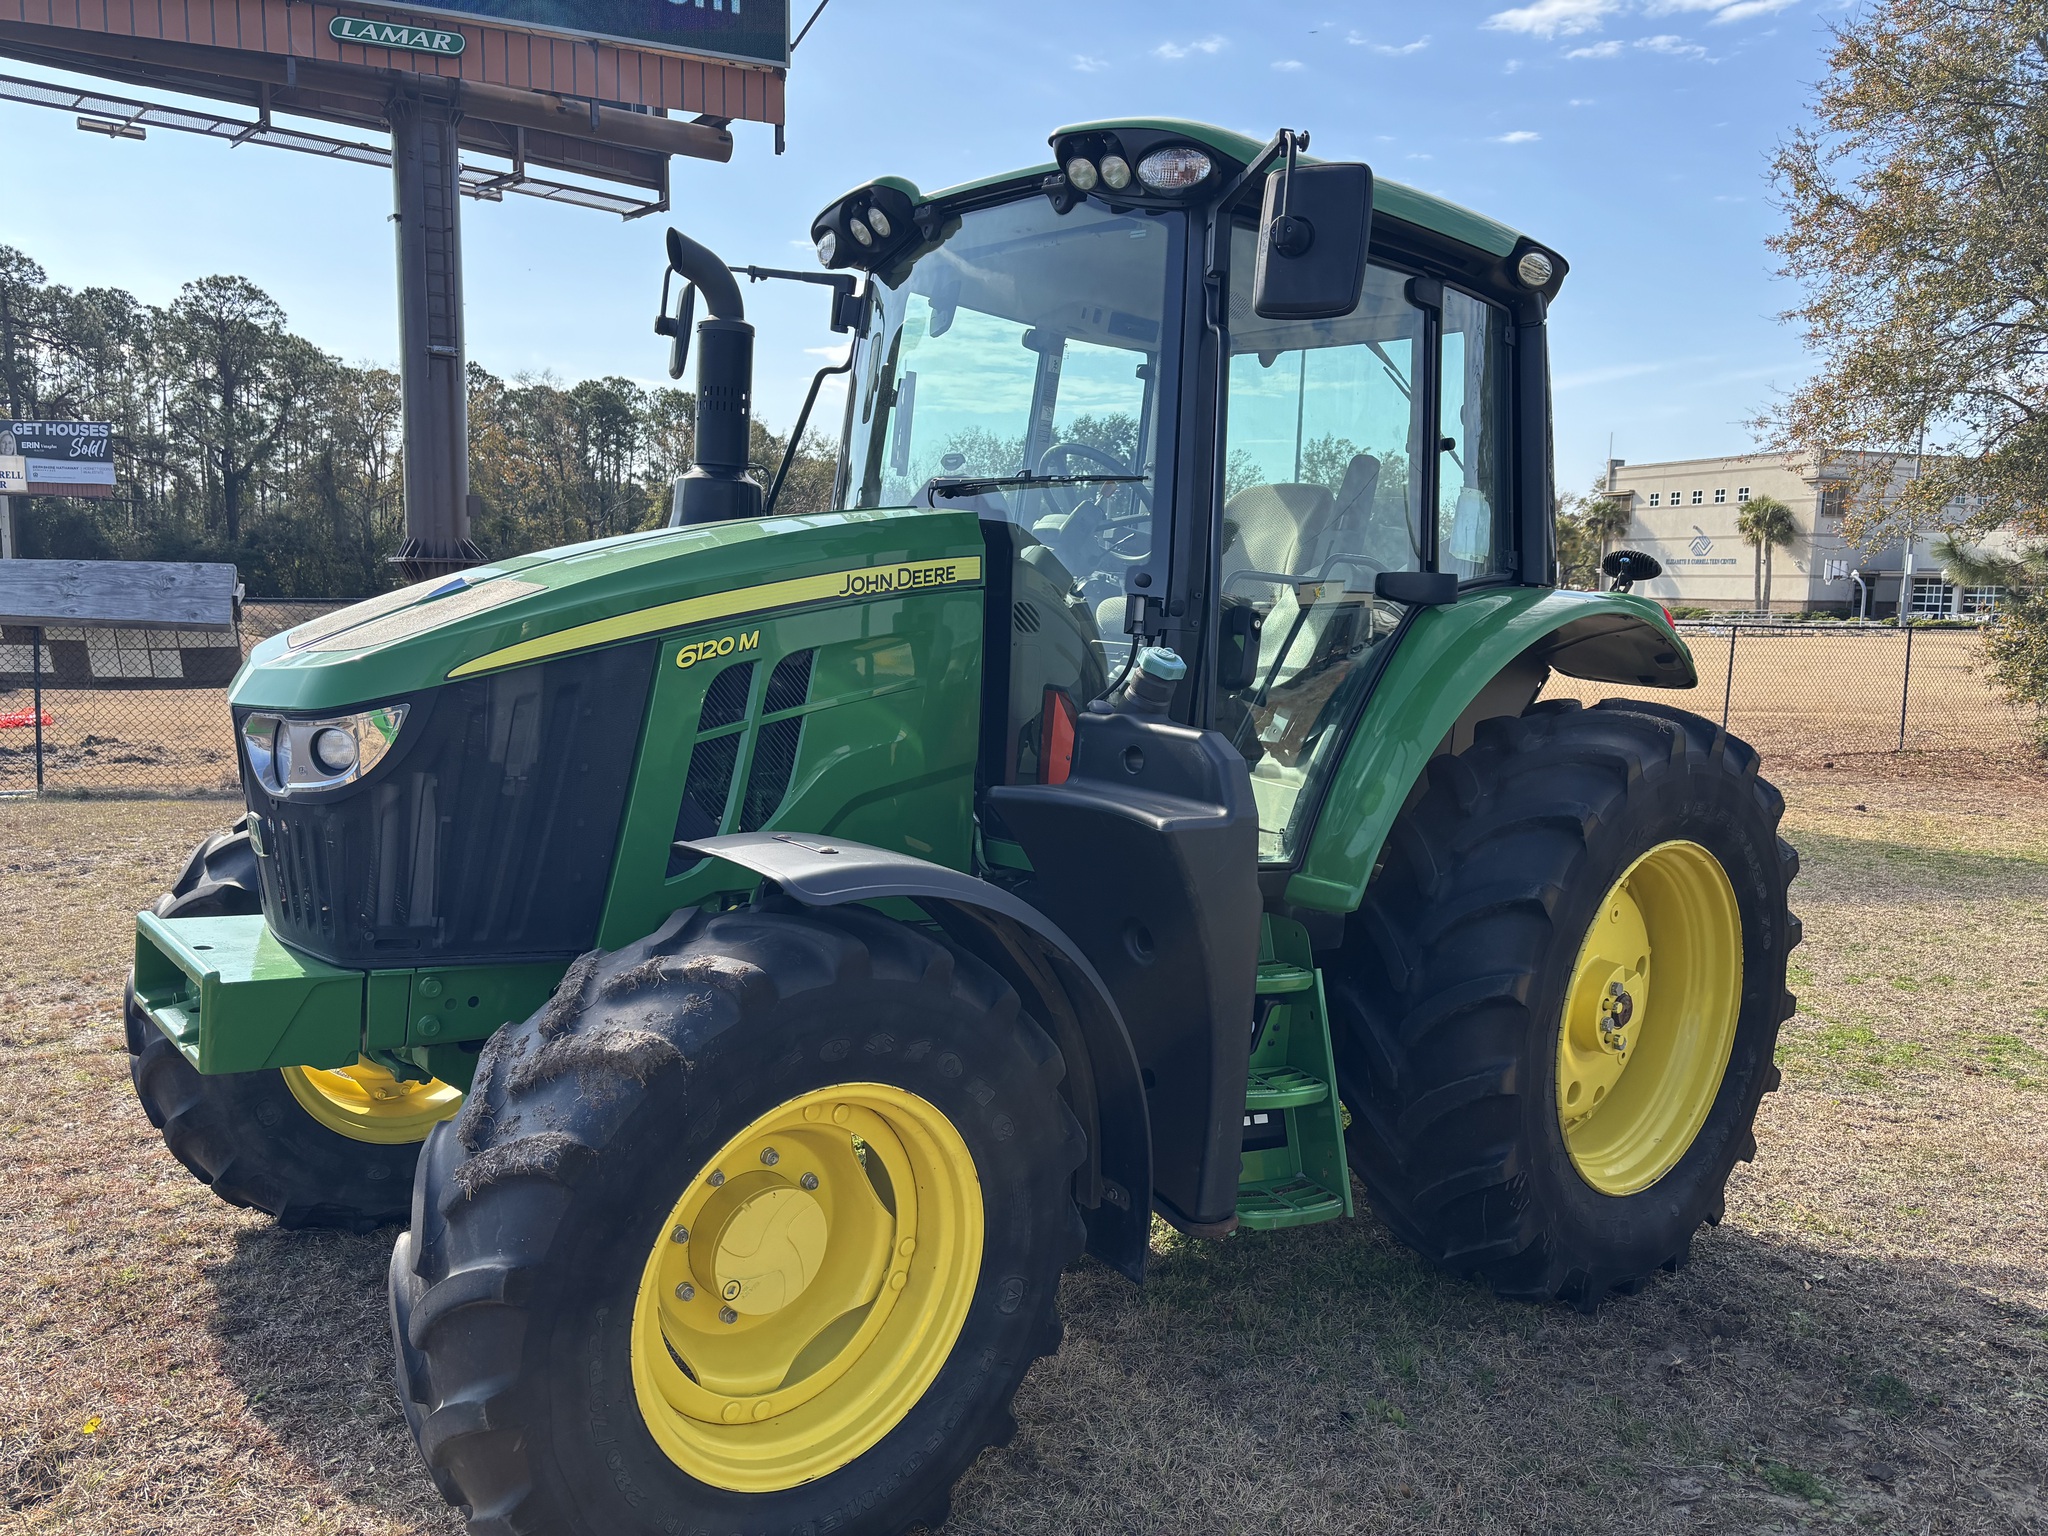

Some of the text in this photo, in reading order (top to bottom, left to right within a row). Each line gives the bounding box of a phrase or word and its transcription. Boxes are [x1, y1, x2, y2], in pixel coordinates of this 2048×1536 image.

[341, 20, 452, 51] LAMAR
[12, 422, 109, 437] GET HOUSES
[21, 441, 40, 449] ERIN
[69, 436, 107, 458] Sold!
[838, 565, 956, 596] JOHN DEERE
[675, 630, 760, 669] 6120 M
